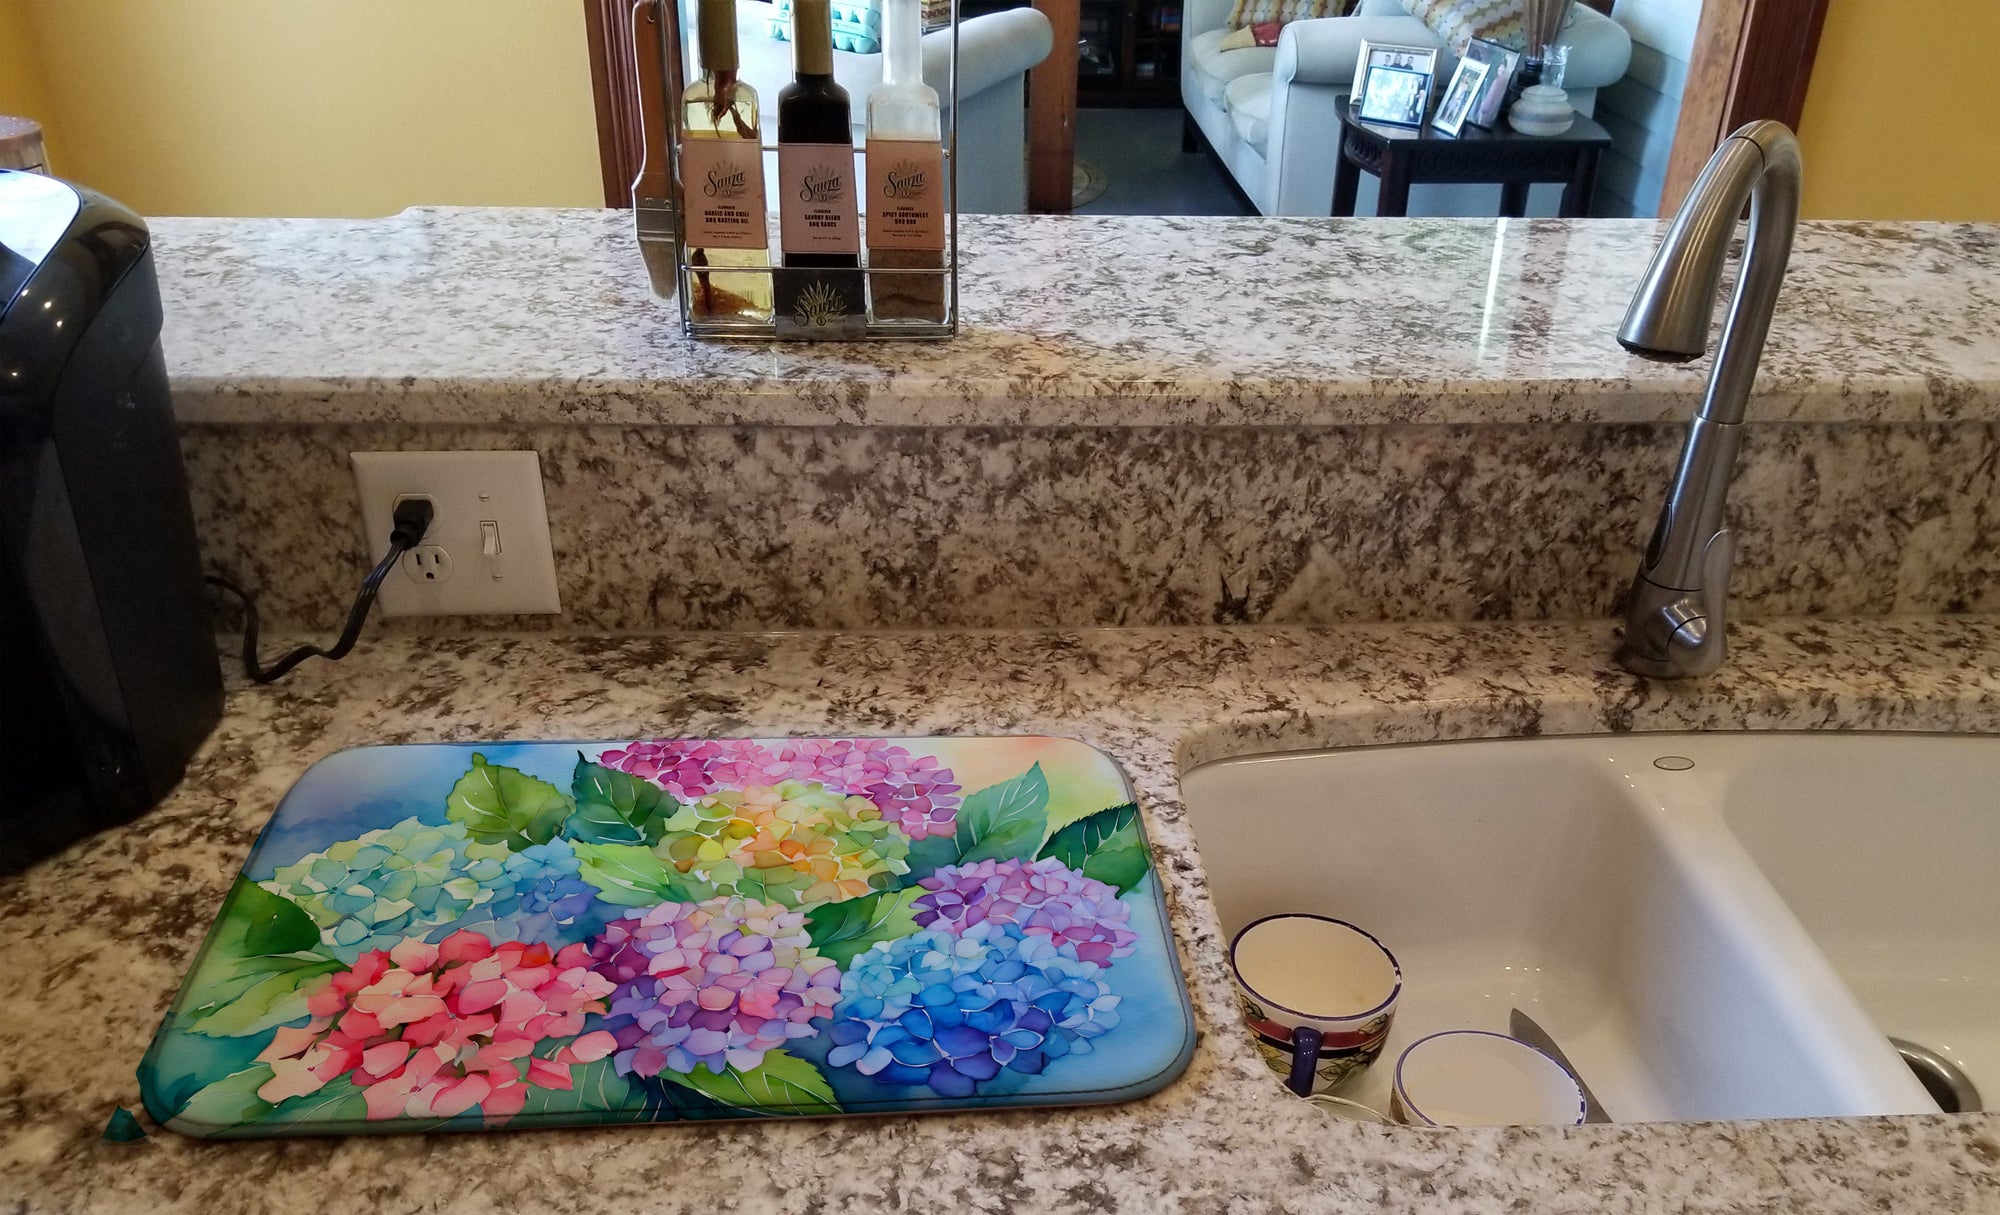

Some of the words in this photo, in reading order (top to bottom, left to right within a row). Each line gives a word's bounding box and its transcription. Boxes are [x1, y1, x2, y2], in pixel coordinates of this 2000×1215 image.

[704, 170, 745, 197] Sauza
[800, 175, 842, 202] Sauza
[884, 171, 925, 198] Sauza
